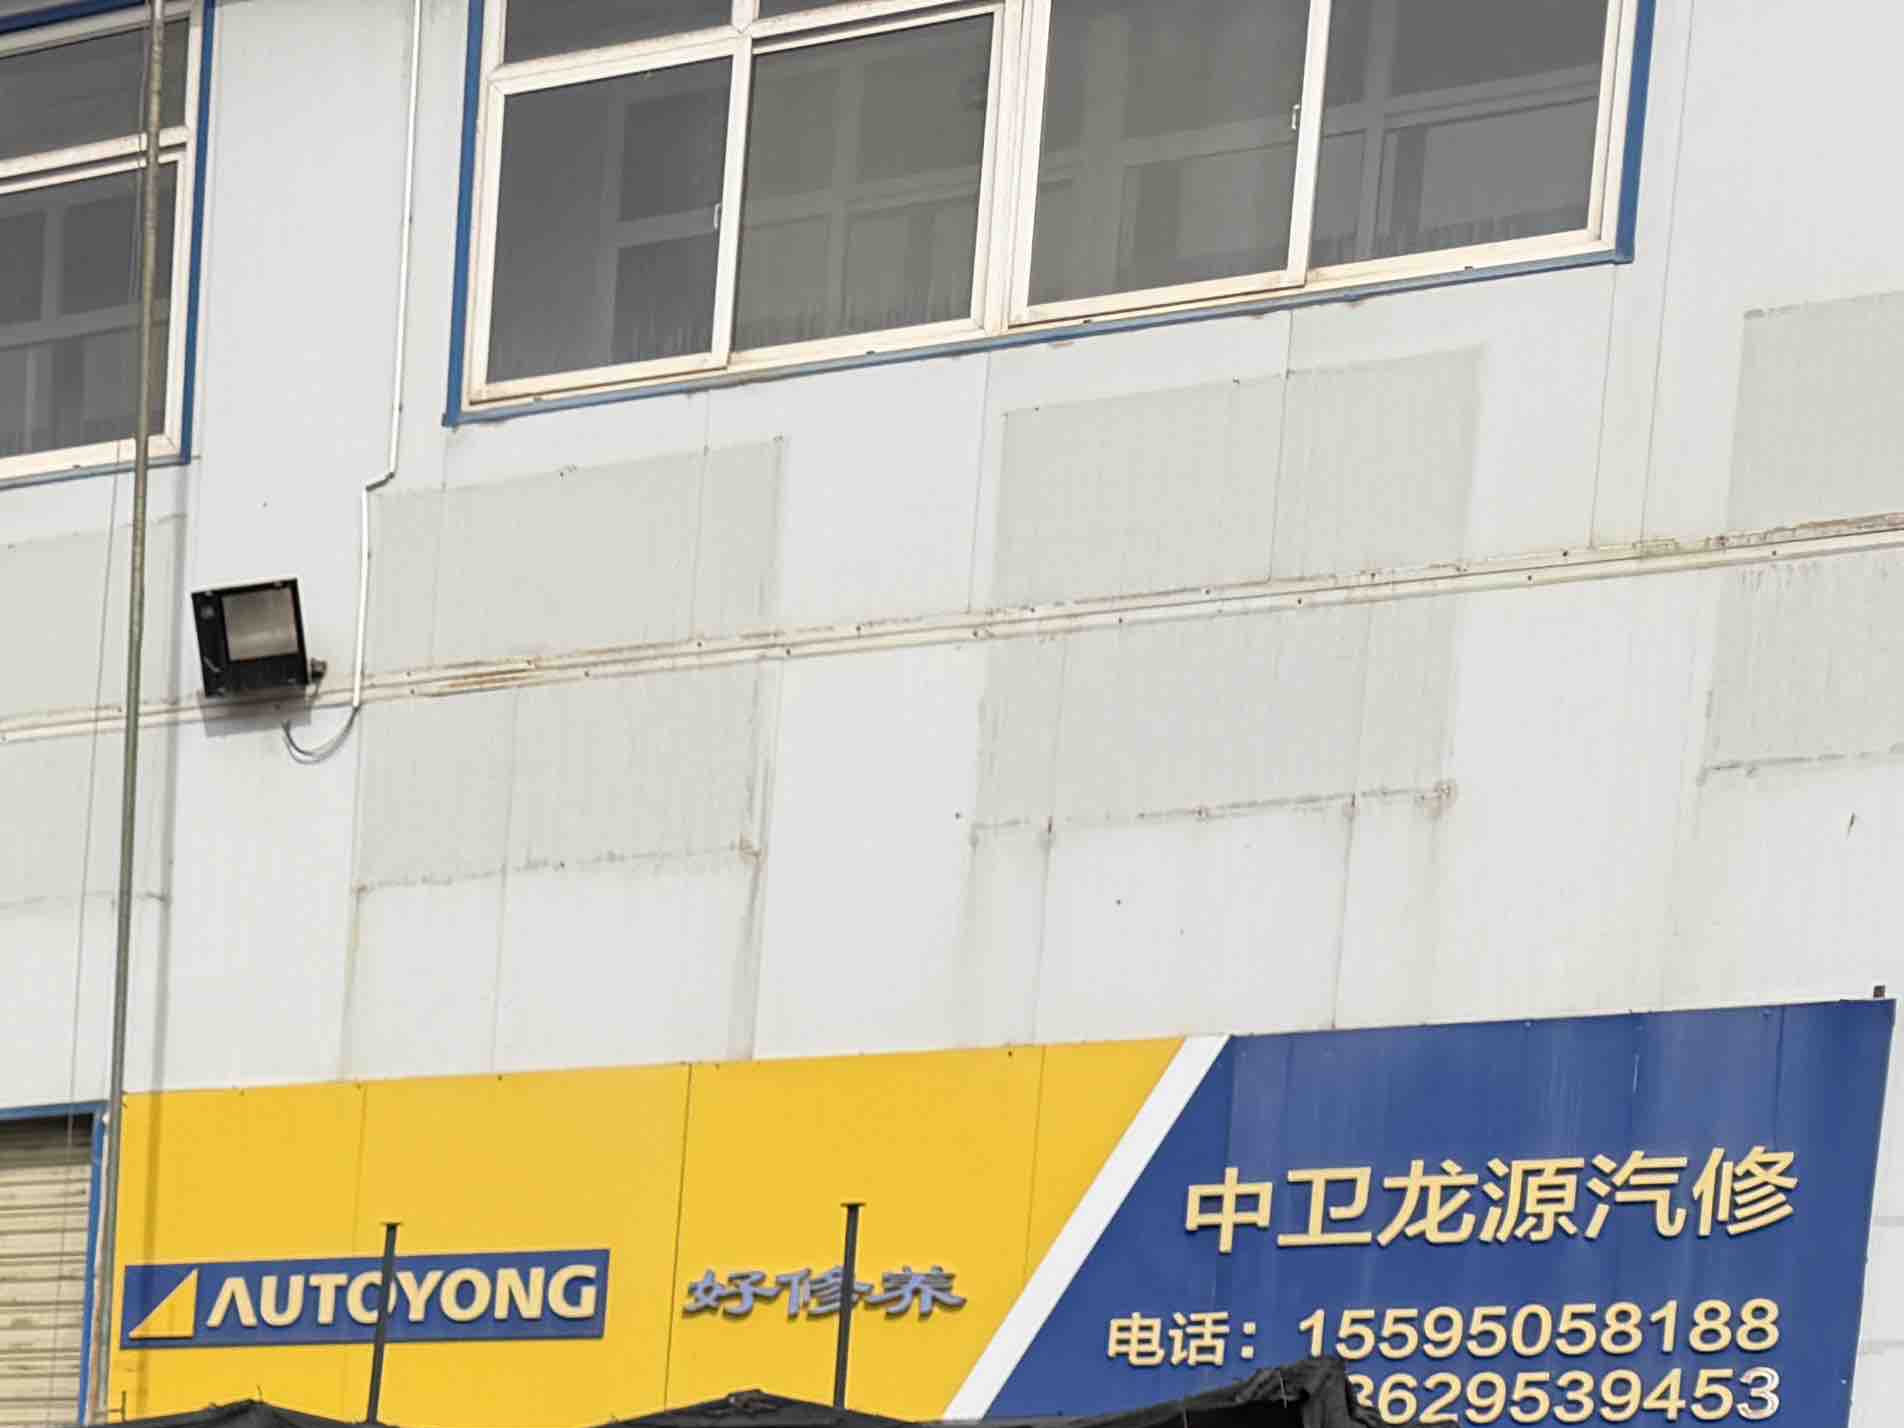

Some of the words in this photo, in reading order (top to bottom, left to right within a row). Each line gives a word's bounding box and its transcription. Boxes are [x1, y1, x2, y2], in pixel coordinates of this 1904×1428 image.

[1184, 1145, 1798, 1254] 中卫龙源汽修
[206, 1263, 598, 1329] AUTOYONG
[1299, 1298, 1780, 1360] 15595058188
[1348, 1366, 1781, 1425] 3629539453
